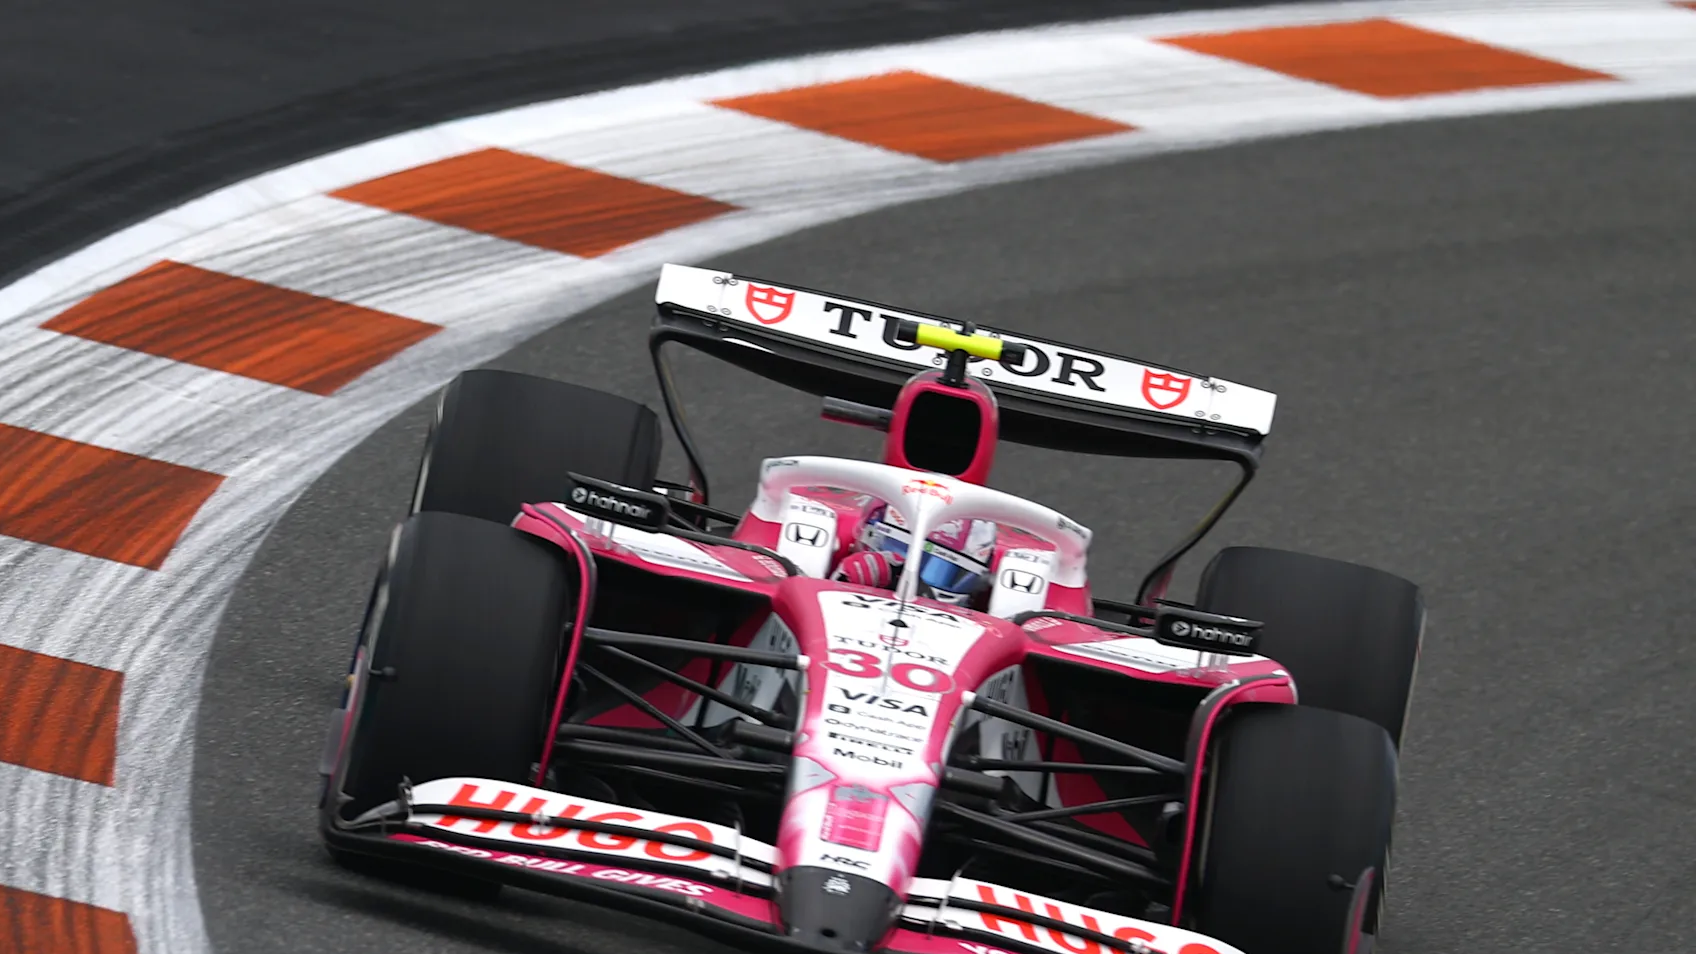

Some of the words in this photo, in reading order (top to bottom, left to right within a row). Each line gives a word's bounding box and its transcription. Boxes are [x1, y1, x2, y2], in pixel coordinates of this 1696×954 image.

[822, 301, 1107, 392] TUOR
[588, 491, 652, 518] hahnair
[852, 594, 960, 622] VISA
[833, 635, 950, 666] TUDOR
[1191, 624, 1253, 647] hahnair
[820, 648, 956, 695] 30
[832, 686, 929, 717] VISA
[833, 748, 903, 769] Mobil
[434, 783, 714, 862] HUGO
[590, 867, 713, 897] GIVES
